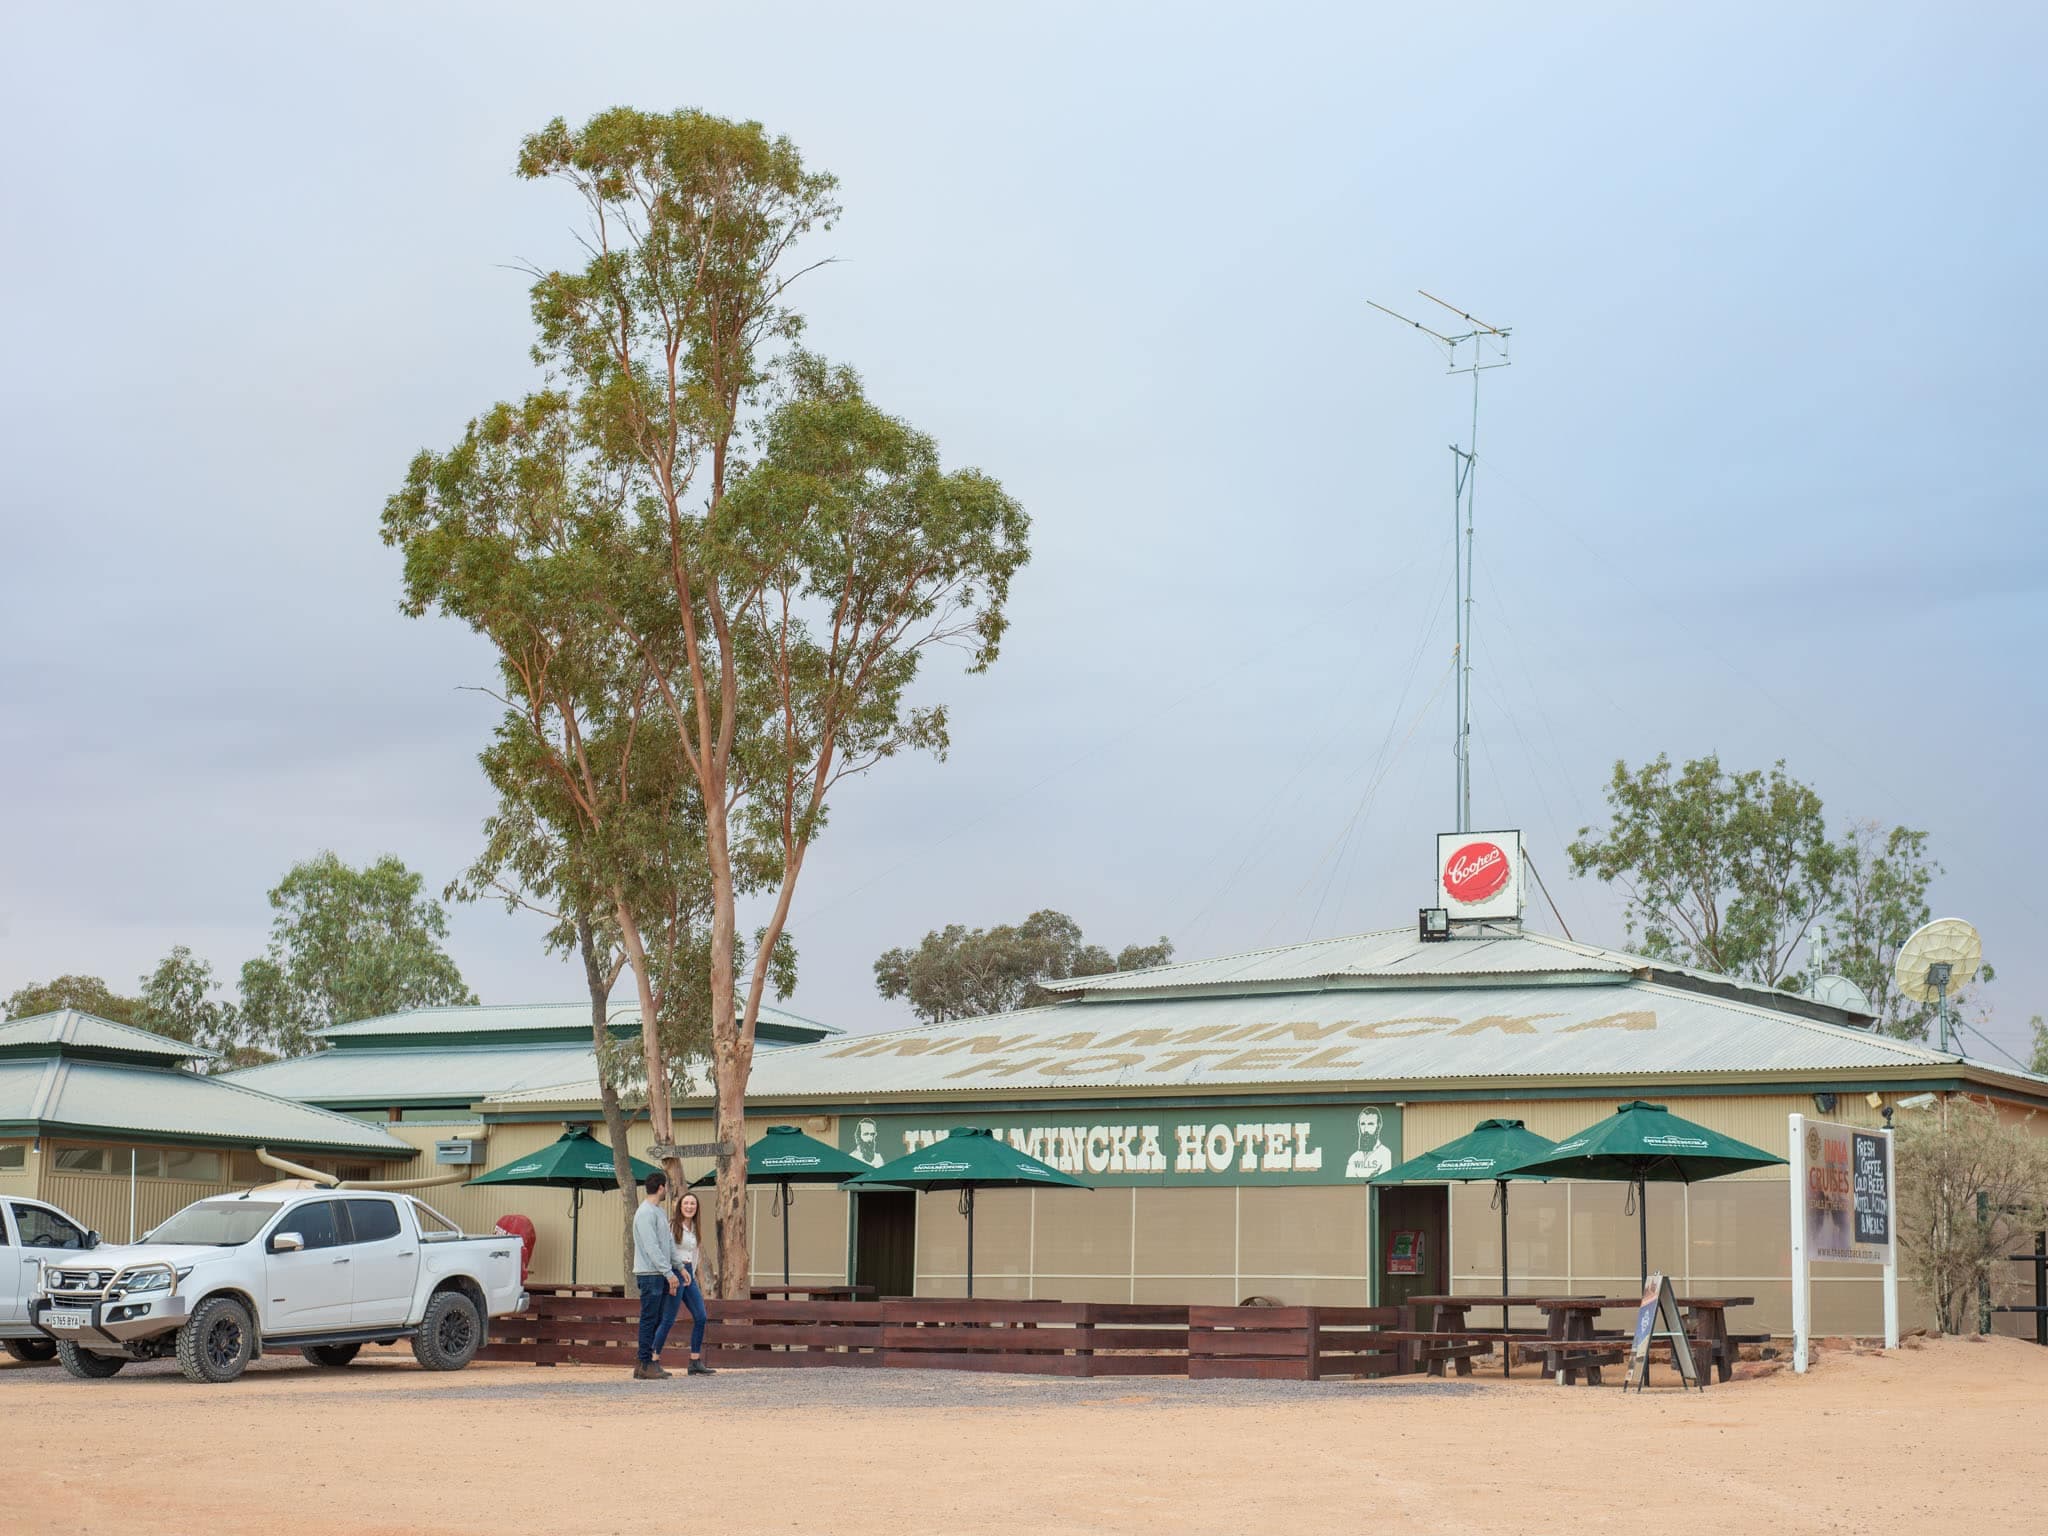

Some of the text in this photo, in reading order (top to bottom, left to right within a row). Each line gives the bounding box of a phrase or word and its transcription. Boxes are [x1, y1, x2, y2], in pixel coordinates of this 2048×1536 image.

[1448, 846, 1500, 884] Coopers
[822, 1010, 1658, 1059] INNAMINCKA
[942, 1045, 1365, 1080] HOTEL
[904, 1122, 1323, 1173] IMINCKA HOTEL
[1856, 1138, 1876, 1158] FRESH
[1354, 1160, 1378, 1169] WILLS
[1809, 1166, 1850, 1194] CRUISES
[1854, 1173, 1868, 1192] COLD
